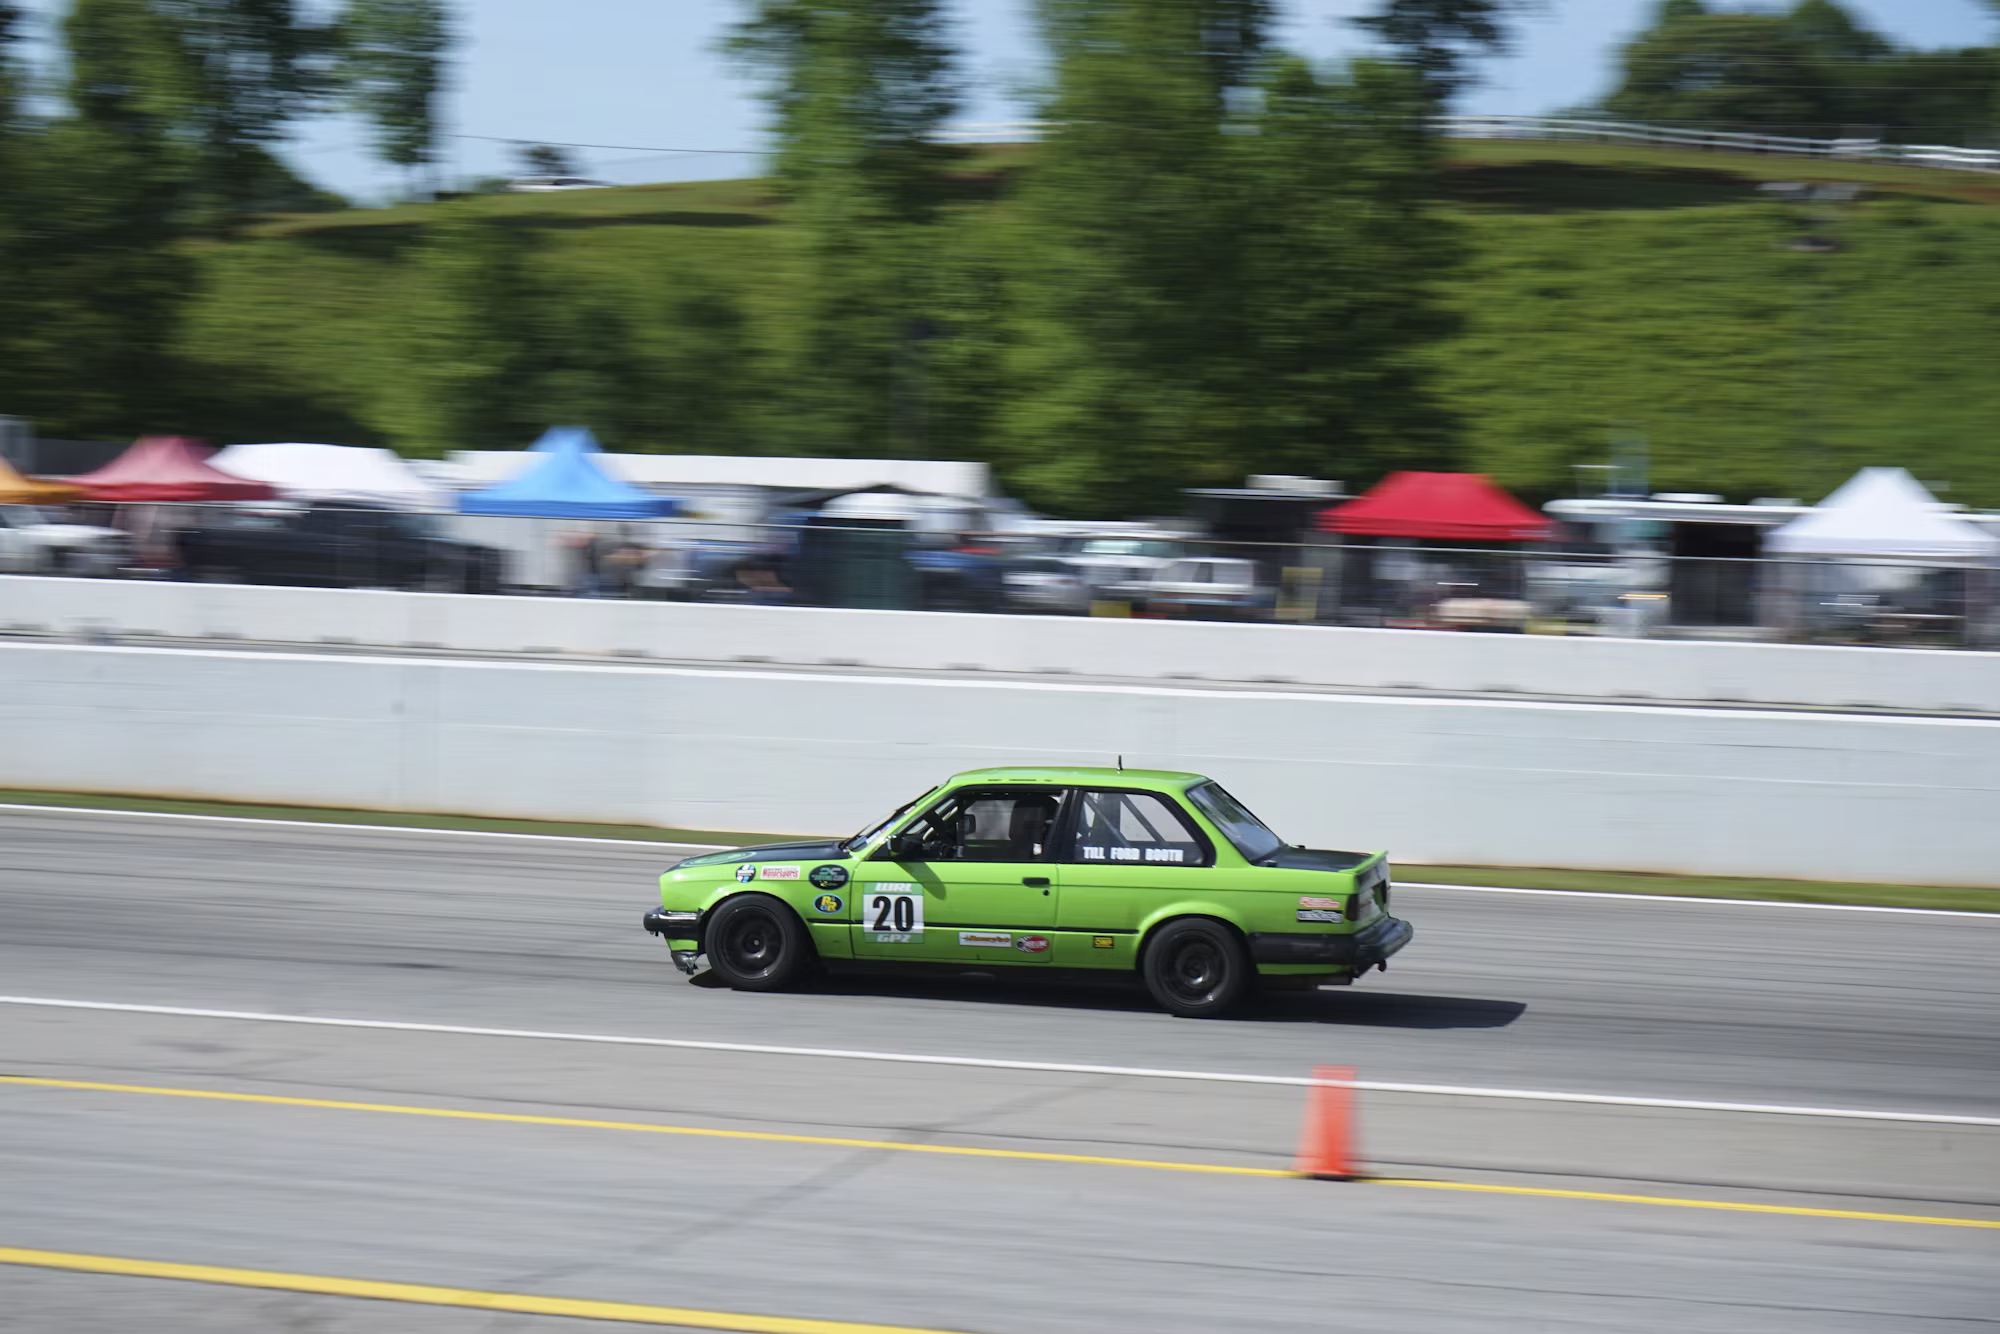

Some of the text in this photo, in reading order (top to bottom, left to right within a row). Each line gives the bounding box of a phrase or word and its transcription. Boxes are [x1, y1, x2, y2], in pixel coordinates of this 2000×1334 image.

[1083, 846, 1105, 860] TILL
[1110, 847, 1140, 860] FORD
[873, 896, 914, 931] 20
